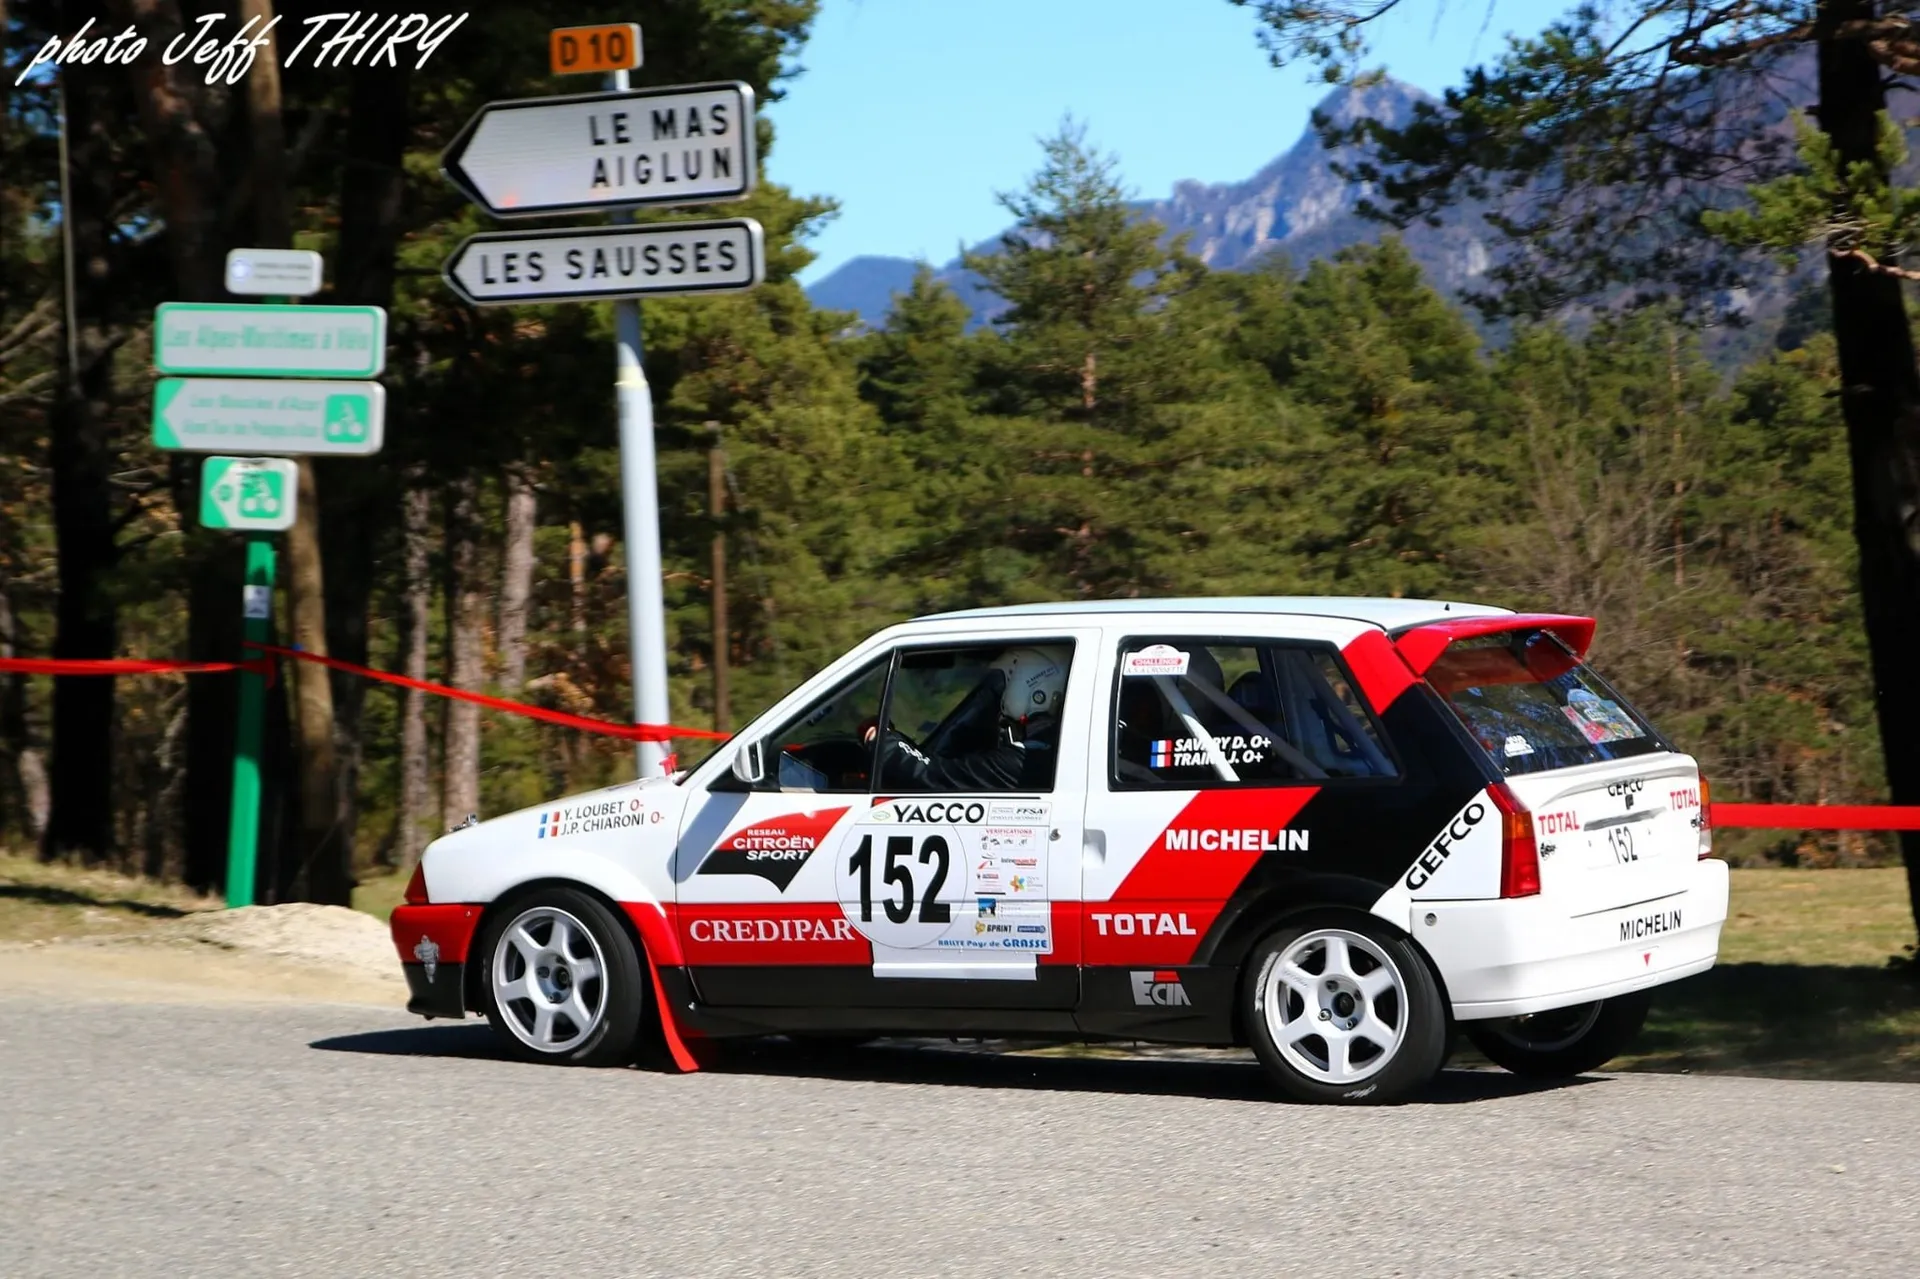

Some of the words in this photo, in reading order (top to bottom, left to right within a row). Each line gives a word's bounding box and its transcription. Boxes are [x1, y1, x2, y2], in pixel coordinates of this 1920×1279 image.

[560, 36, 578, 67] D
[588, 31, 626, 64] 10
[589, 112, 632, 147] LE
[652, 104, 729, 140] MAS
[591, 148, 732, 188] AIGLUN
[481, 252, 544, 285] LES
[566, 240, 738, 280] SAUSSES
[1232, 736, 1247, 749] D.
[1229, 751, 1240, 764] J.
[1607, 778, 1645, 796] GEFCO
[1670, 787, 1699, 810] TOTAL
[564, 809, 573, 820] Y.
[576, 801, 624, 819] LOUBET
[893, 803, 985, 823] YACCO
[560, 822, 579, 835] J.P.
[583, 813, 645, 833] CHIARONI
[1538, 810, 1580, 835] TOTAL
[733, 835, 815, 849] CITROËN
[1165, 829, 1309, 851] MICHELIN
[1405, 802, 1485, 890] GEFCO
[1608, 826, 1638, 864] 152
[746, 850, 810, 861] SPORT
[849, 834, 951, 924] 152
[690, 919, 855, 942] CREDIPAR
[1091, 913, 1197, 936] TOTAL
[1620, 909, 1682, 941] MICHELIN
[1002, 939, 1048, 948] GRASSE
